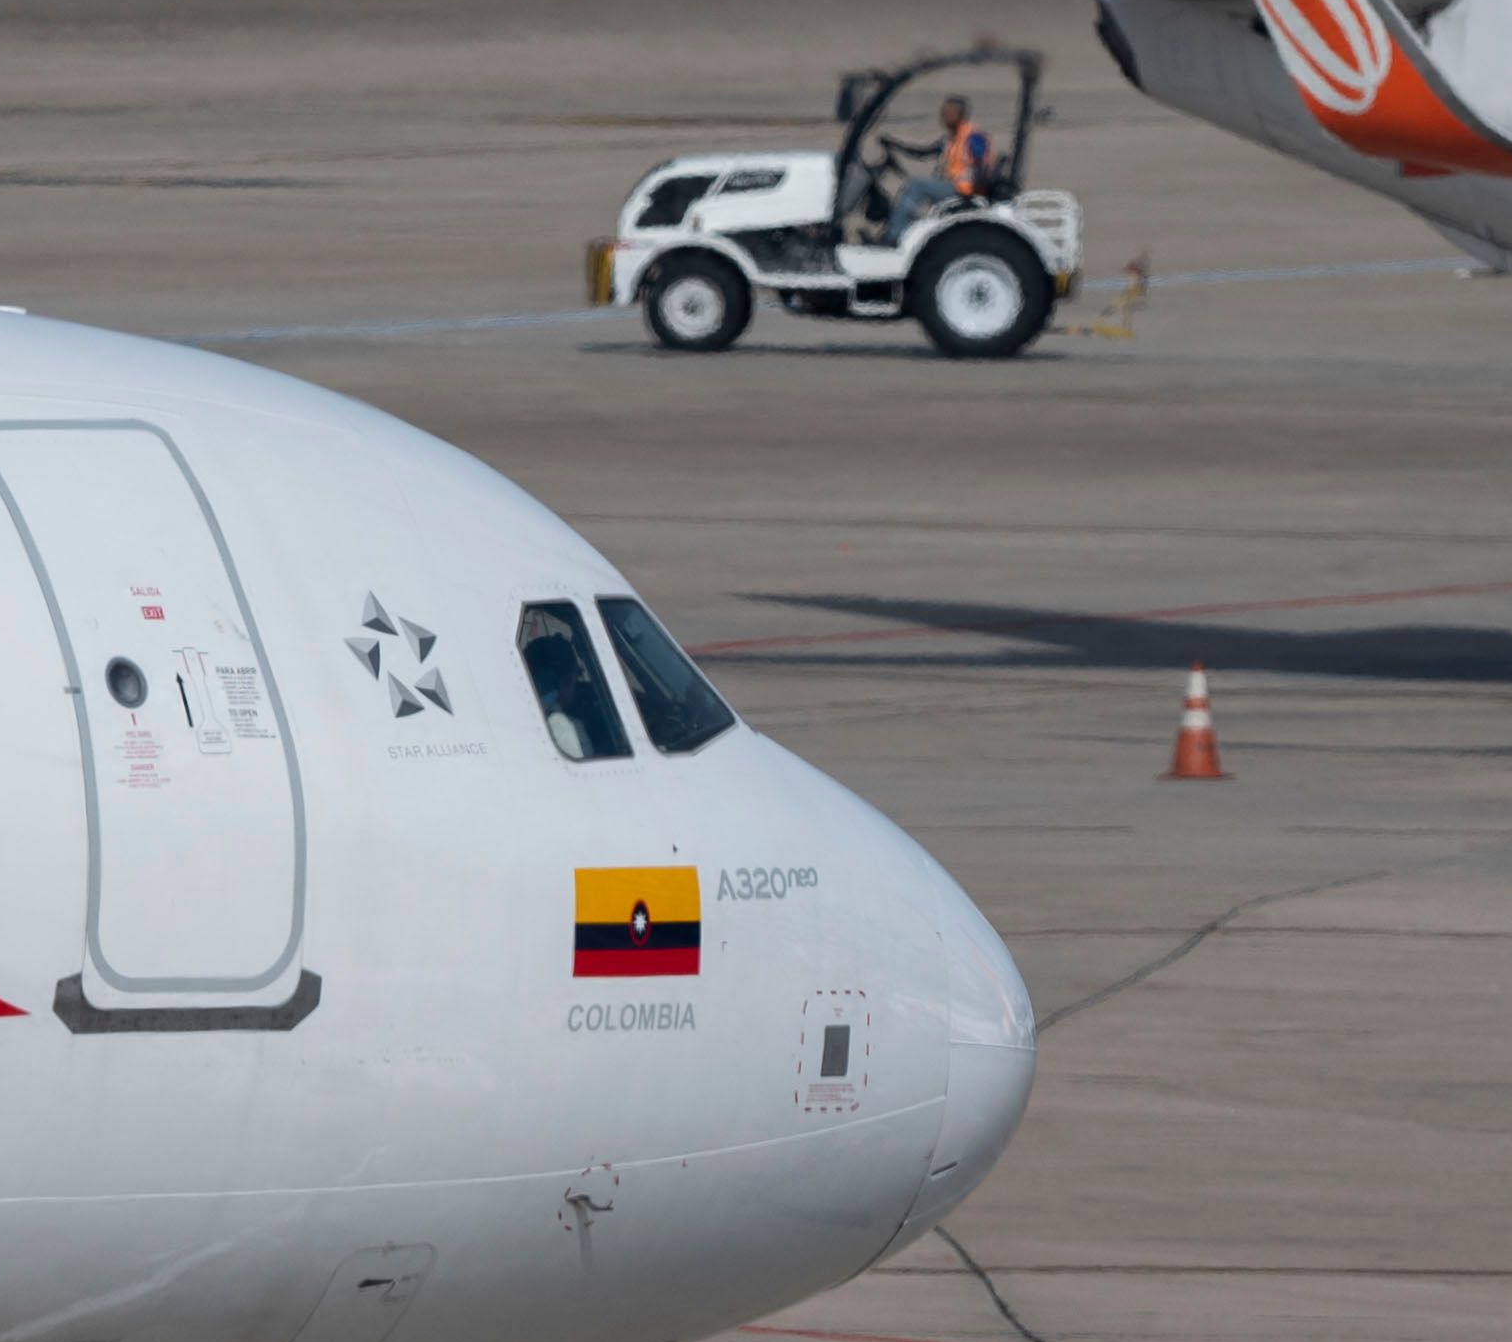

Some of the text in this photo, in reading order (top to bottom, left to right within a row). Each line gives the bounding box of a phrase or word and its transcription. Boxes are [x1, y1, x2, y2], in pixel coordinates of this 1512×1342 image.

[388, 745, 423, 760] STAR
[717, 867, 819, 902] A320neo
[567, 1002, 696, 1033] COLOMBIA
